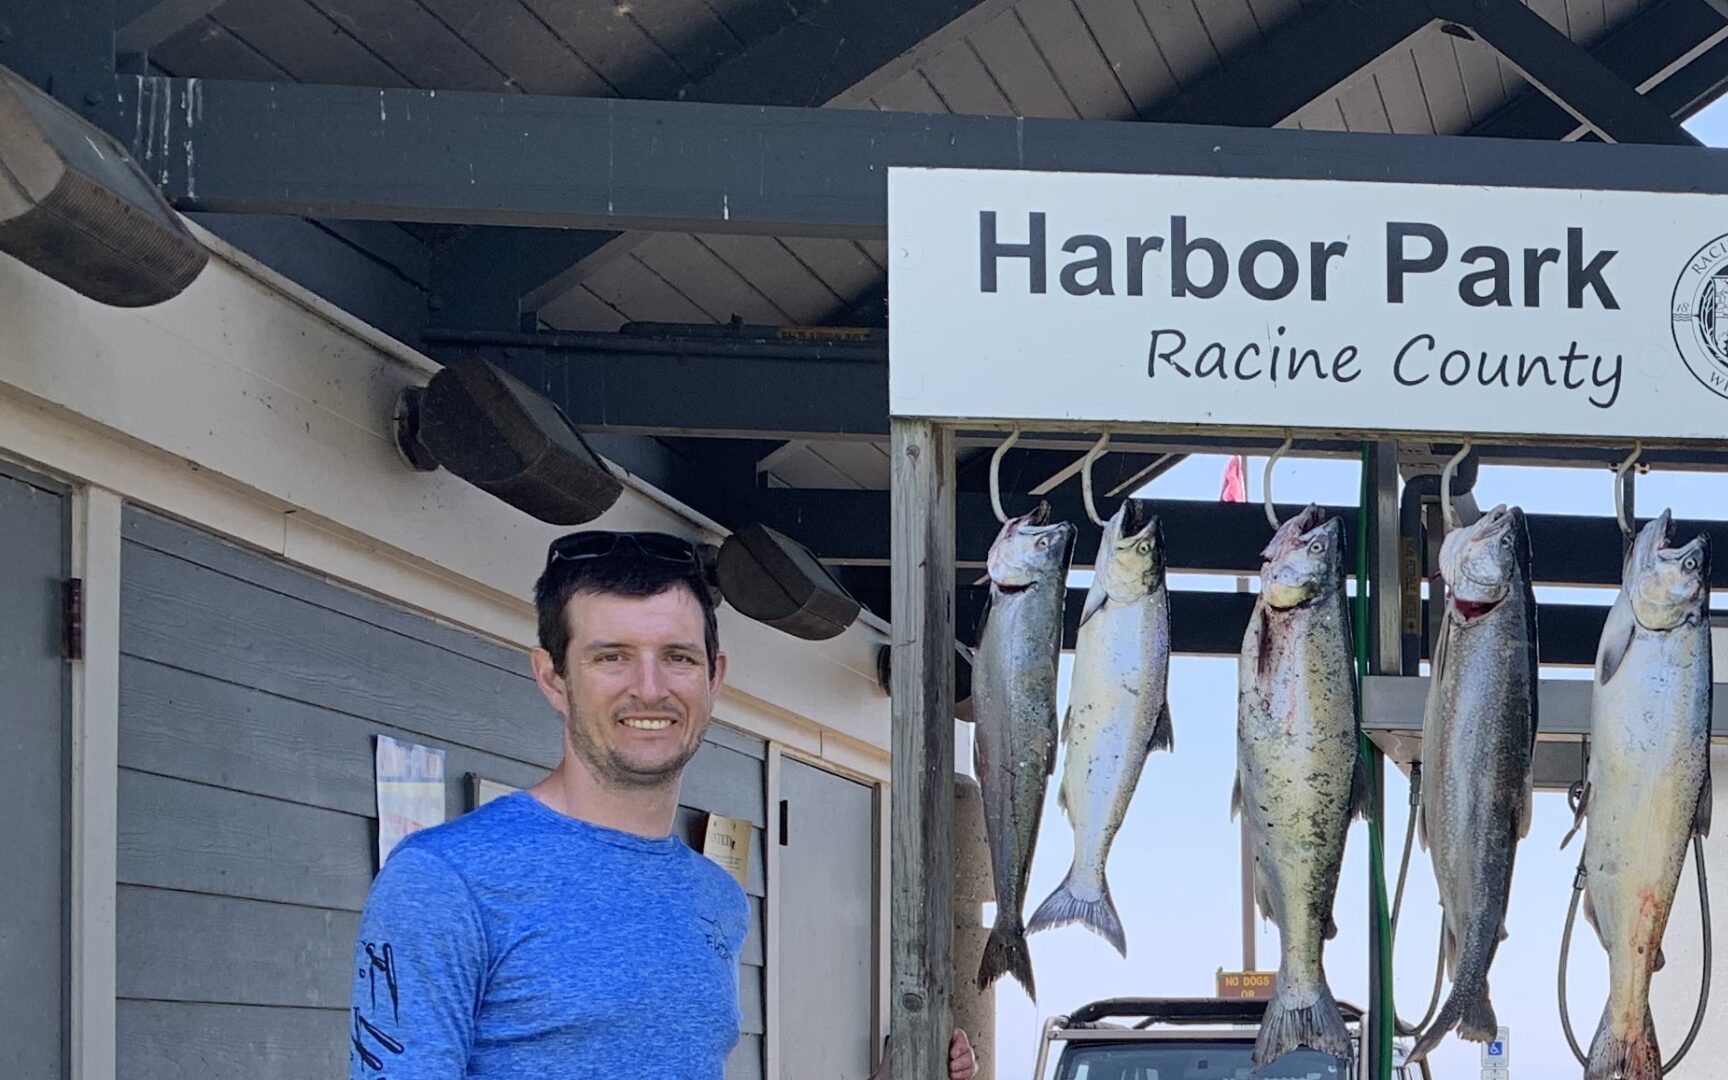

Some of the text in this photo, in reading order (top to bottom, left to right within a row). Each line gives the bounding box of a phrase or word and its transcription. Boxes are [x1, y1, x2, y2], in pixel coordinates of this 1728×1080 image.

[979, 210, 1622, 310] Harbor Park
[1144, 325, 1624, 409] Racine County
[1225, 976, 1270, 987] NO DOGS
[1241, 989, 1255, 998] OR
